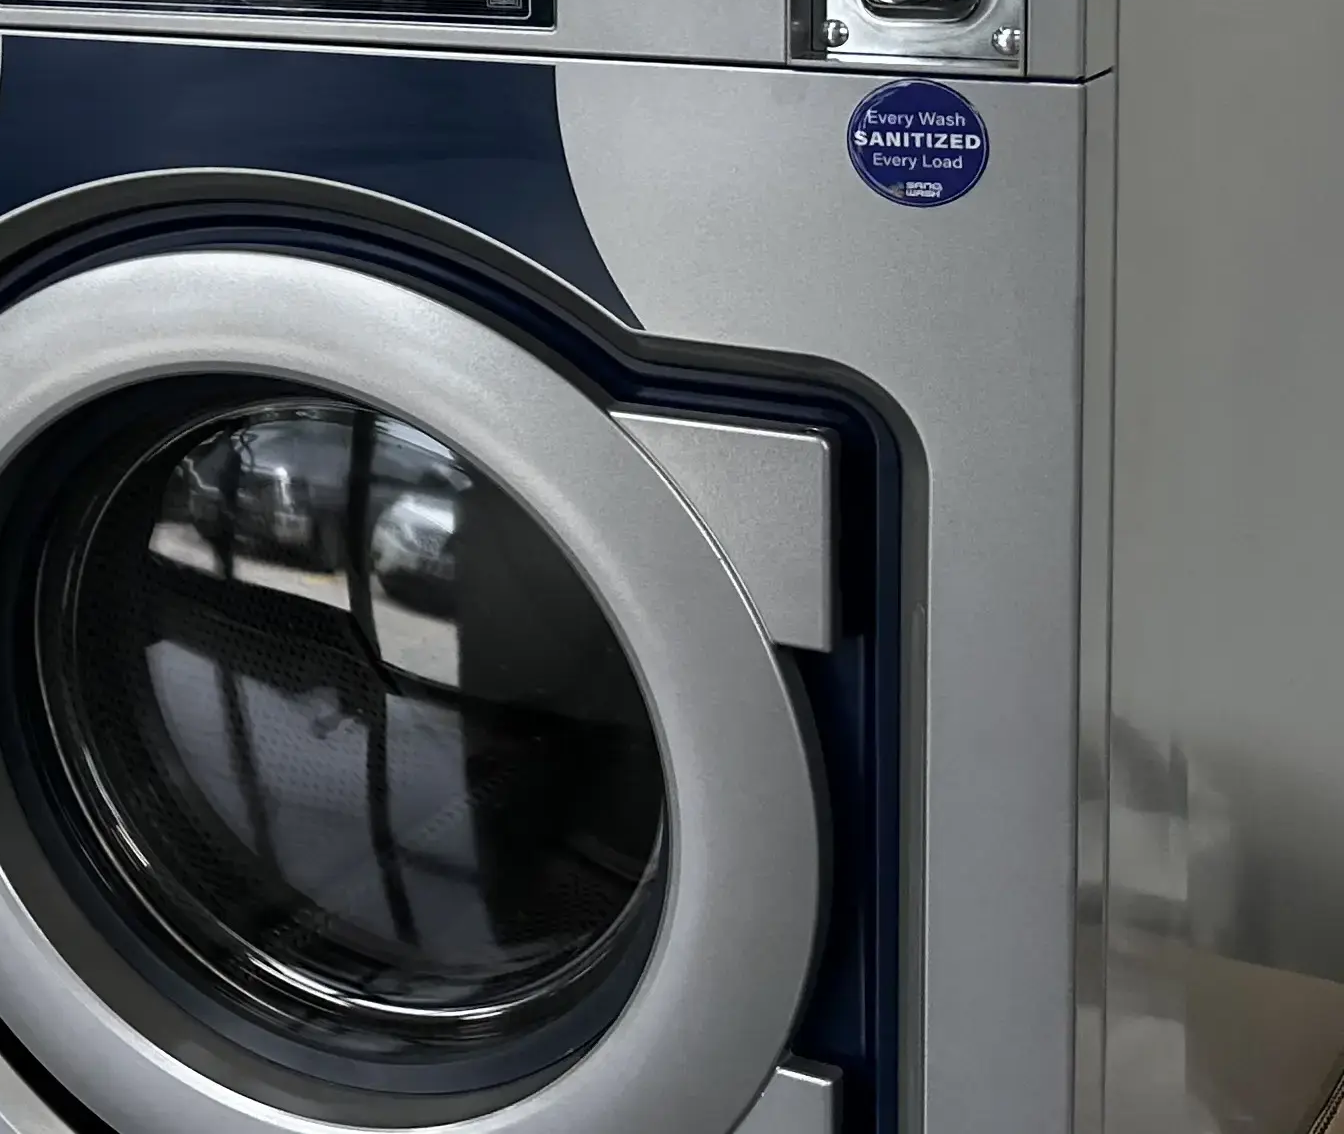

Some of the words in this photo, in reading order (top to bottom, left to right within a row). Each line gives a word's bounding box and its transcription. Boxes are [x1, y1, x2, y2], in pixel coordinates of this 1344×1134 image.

[867, 109, 914, 129] Every
[918, 111, 966, 127] Wash
[854, 130, 982, 150] SANITIZED
[872, 152, 918, 171] Every
[922, 154, 963, 170] Load
